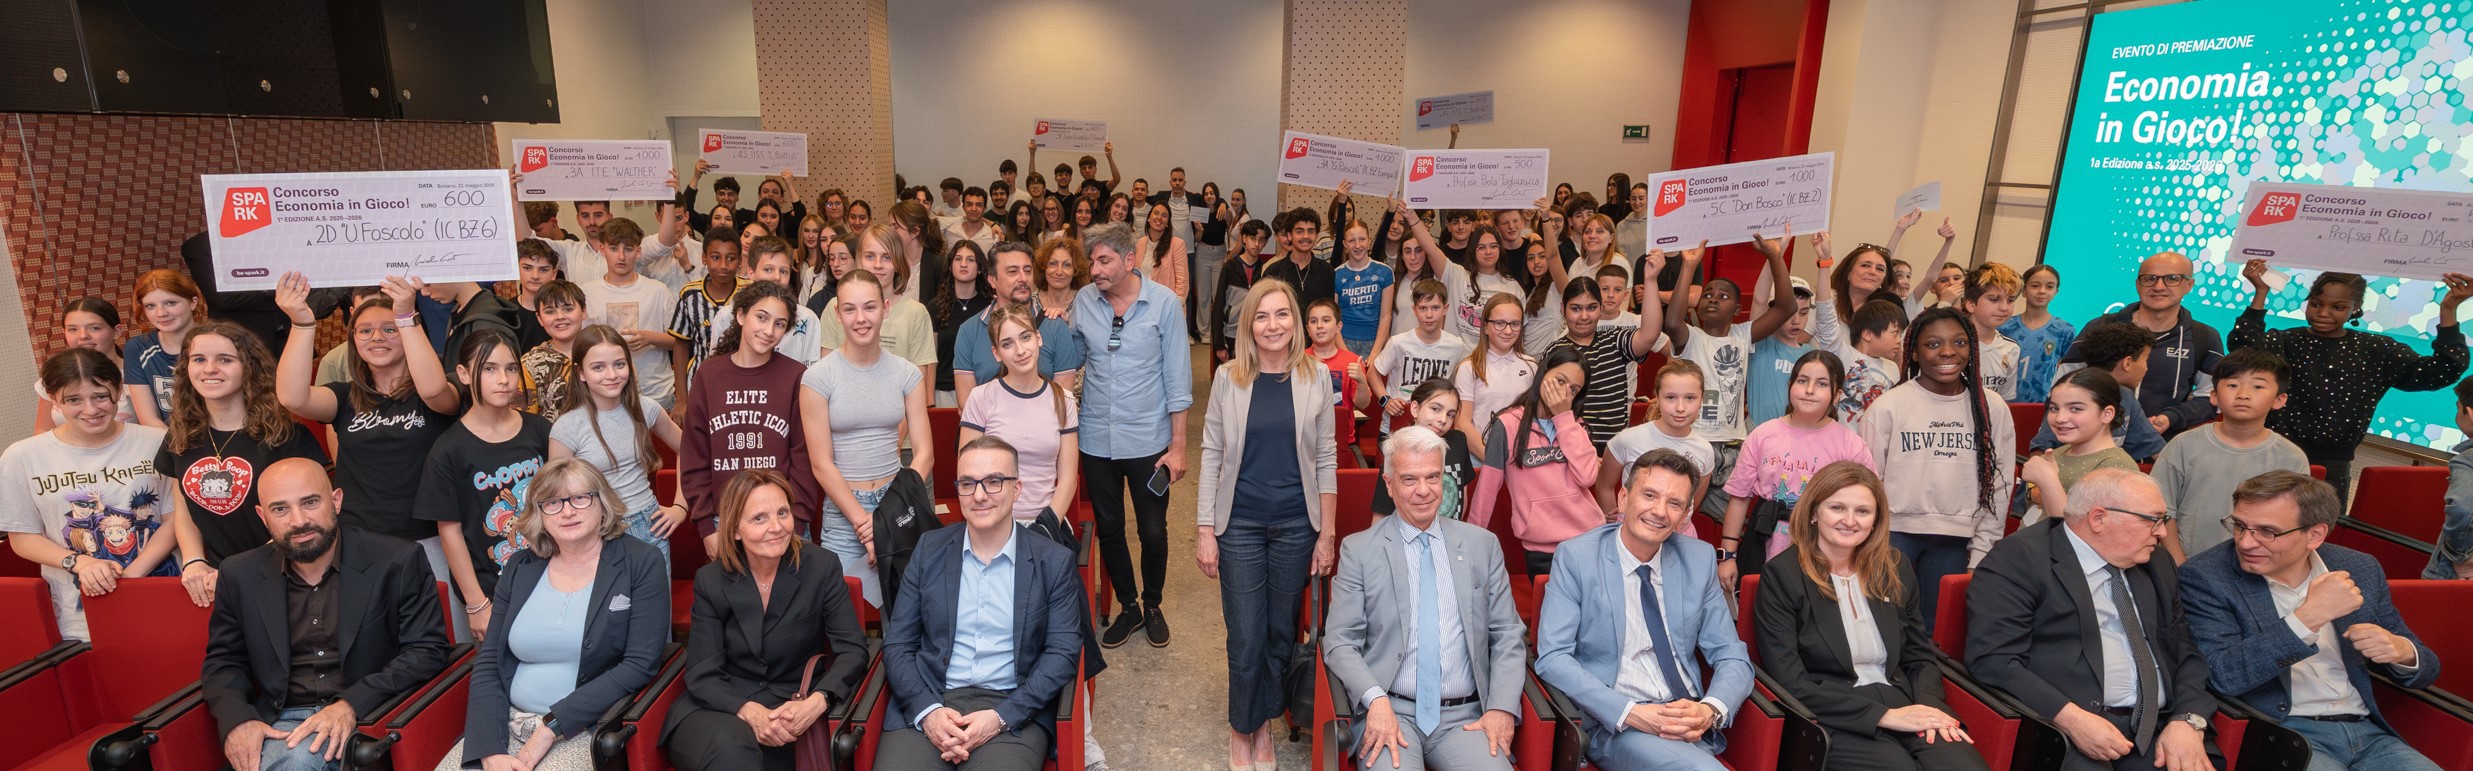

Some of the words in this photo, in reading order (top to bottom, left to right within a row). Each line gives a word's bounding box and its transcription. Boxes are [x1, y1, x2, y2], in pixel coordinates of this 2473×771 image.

[2112, 44, 2155, 59] EVENTO
[2156, 43, 2169, 55] DI
[2170, 35, 2255, 54] PREMIAZIONE
[2104, 62, 2270, 102] Economia
[2095, 112, 2123, 143] in
[2132, 109, 2244, 144] Gioco!
[1293, 139, 1307, 148] SPA
[1310, 140, 1337, 149] Concorso
[527, 149, 545, 157] SPA
[596, 153, 619, 161] Gioco!
[636, 150, 661, 160] 1000
[1309, 146, 1337, 156] Economia
[1417, 158, 1432, 167] SPA
[1477, 162, 1500, 170] Gioco!
[1514, 159, 1533, 169] 500
[2090, 157, 2101, 168] 1a
[2102, 157, 2143, 169] Edizione
[2145, 160, 2164, 169] a.s.
[2166, 158, 2223, 171] 2025-2026
[1416, 166, 1428, 174] RK
[1789, 169, 1815, 182] 1000
[1688, 175, 1728, 187] Concorso
[1688, 183, 1730, 196] Economia
[1731, 182, 1740, 191] in
[1741, 178, 1770, 189] Gioco!
[272, 187, 340, 198] Concorso
[1664, 183, 1684, 195] SPA
[231, 191, 267, 206] SPA
[275, 199, 345, 212] Economia
[348, 199, 361, 210] in
[365, 198, 410, 210] Gioco!
[444, 190, 485, 206] 600
[1663, 194, 1678, 205] RK
[2267, 195, 2296, 207] SPA
[2305, 194, 2367, 206] Concorso
[233, 206, 259, 221] RK
[1711, 200, 1727, 216] 5C
[2264, 206, 2286, 217] RK
[2302, 204, 2366, 217] Economia
[2370, 208, 2382, 217] in
[2386, 209, 2433, 220] Gioco!
[315, 224, 337, 243] 2D
[2377, 227, 2408, 243] Rita
[1342, 284, 1378, 296] PUERTO
[1350, 295, 1372, 305] RICO
[2166, 347, 2190, 357] EA7
[1400, 356, 1450, 387] LEONE
[1775, 358, 1794, 374] PU
[2020, 355, 2031, 380] 1
[725, 390, 768, 405] ELITE
[709, 410, 762, 435] THLETIC
[763, 413, 790, 438] ICON
[728, 432, 763, 450] 1991
[1900, 431, 1937, 452] NEW
[1937, 432, 1980, 452] JERS
[1527, 449, 1555, 465] Sport
[1933, 450, 1958, 458] Omega
[191, 463, 218, 475] Betty
[226, 460, 249, 478] Boop
[714, 458, 740, 471] SAN
[743, 456, 776, 469] DIEGO
[473, 454, 545, 491] CHOPP
